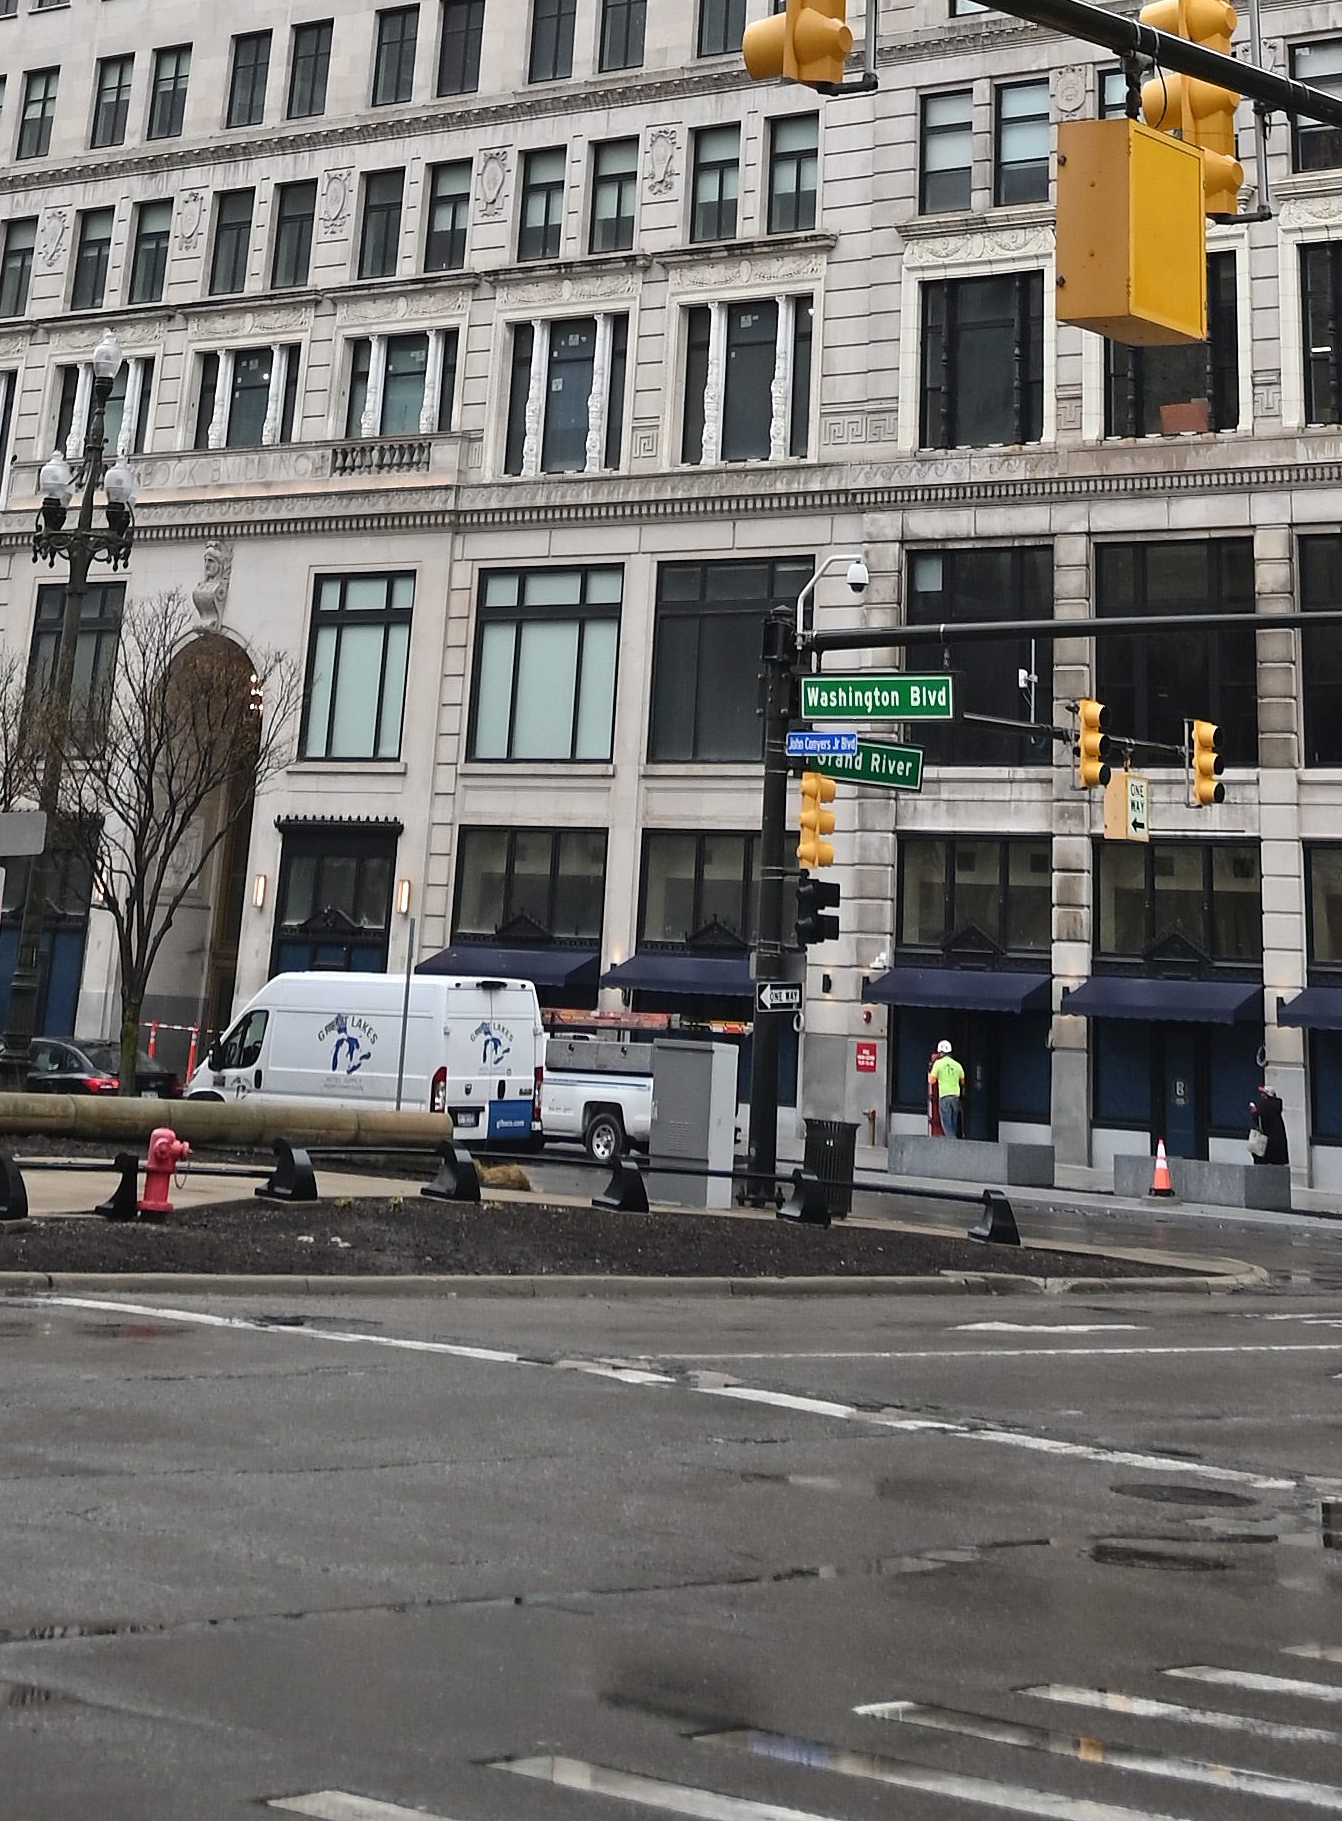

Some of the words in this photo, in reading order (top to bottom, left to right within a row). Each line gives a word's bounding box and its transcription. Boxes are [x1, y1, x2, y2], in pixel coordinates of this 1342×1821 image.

[143, 459, 201, 487] BOOK
[807, 685, 900, 713] Washington
[910, 685, 947, 707] Blvd
[788, 737, 804, 751] John
[804, 736, 832, 753] Conyers
[840, 736, 856, 751] Blvd
[817, 751, 864, 771] Grand
[870, 753, 913, 777] River
[1130, 783, 1144, 798] ONE
[1130, 799, 1145, 814] WAY
[770, 989, 783, 1004] ONE
[785, 989, 798, 1003] WAY
[350, 1015, 379, 1045] LAKES
